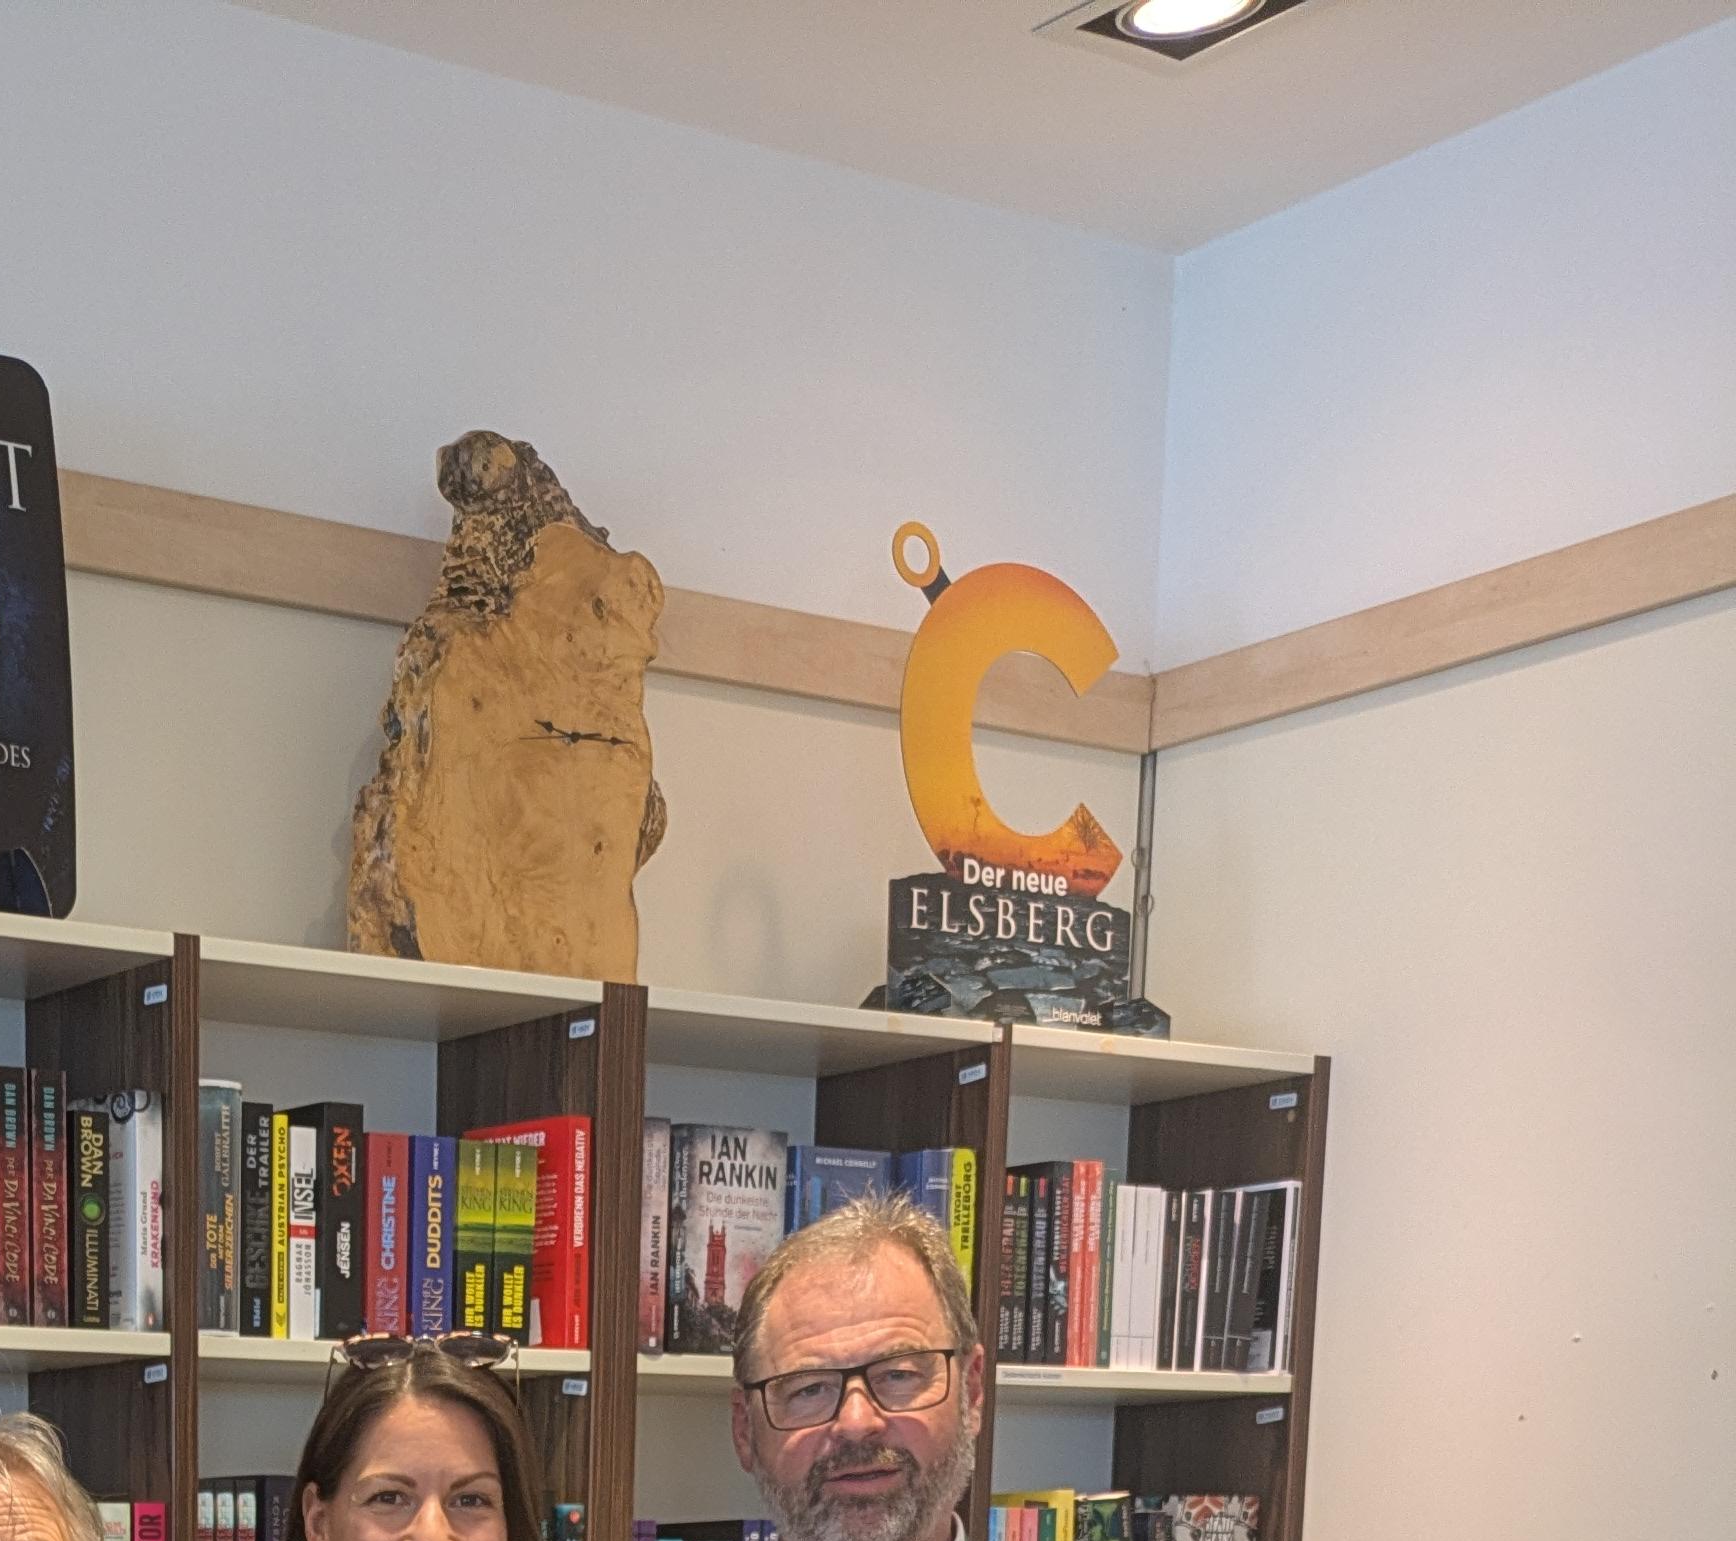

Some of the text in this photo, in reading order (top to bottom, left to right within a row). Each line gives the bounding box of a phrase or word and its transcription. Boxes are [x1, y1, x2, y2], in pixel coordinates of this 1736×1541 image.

[964, 858, 1069, 898] Der neue
[909, 886, 1115, 953] ELSBERG
[4, 1083, 17, 1149] DAN BROWN
[43, 1087, 55, 1151] DAN BROWN
[80, 1116, 93, 1188] BROWN
[91, 1134, 103, 1176] DAN
[221, 1105, 232, 1187] GALBRAITH
[246, 1134, 257, 1169] DER
[258, 1116, 270, 1188] TRAILER
[332, 1126, 351, 1197] OXEN
[710, 1134, 748, 1162] IAN
[277, 1126, 286, 1248] AUSTRIAN PSYCHO
[294, 1168, 314, 1220] INSEL
[574, 1172, 585, 1194] DAS
[698, 1161, 778, 1191] RANKIN
[707, 1192, 722, 1205] Die
[151, 1180, 159, 1269] KRAKENKIND
[206, 1214, 217, 1249] TOTE
[381, 1175, 396, 1271] CHRISTINE
[427, 1175, 443, 1269] DUDDITS
[461, 1197, 494, 1212] KING
[499, 1197, 533, 1214] KING
[573, 1195, 584, 1248] VERBRENN
[699, 1206, 734, 1218] Stunde
[735, 1208, 749, 1219] der
[953, 1184, 962, 1227] TATORT
[961, 1161, 973, 1251] TRELLEBORG
[85, 1229, 99, 1311] ILLUMINATI
[224, 1194, 234, 1291] SILBERZEICHEN
[339, 1222, 351, 1279] JENSEN
[649, 1216, 661, 1296] IAN RANKIN
[429, 1278, 444, 1332] KING
[465, 1271, 475, 1327] IHR WOLLT
[475, 1264, 485, 1312] DUNKLER
[502, 1272, 514, 1328] IHR WOLLT
[513, 1265, 524, 1312] DUNKLER
